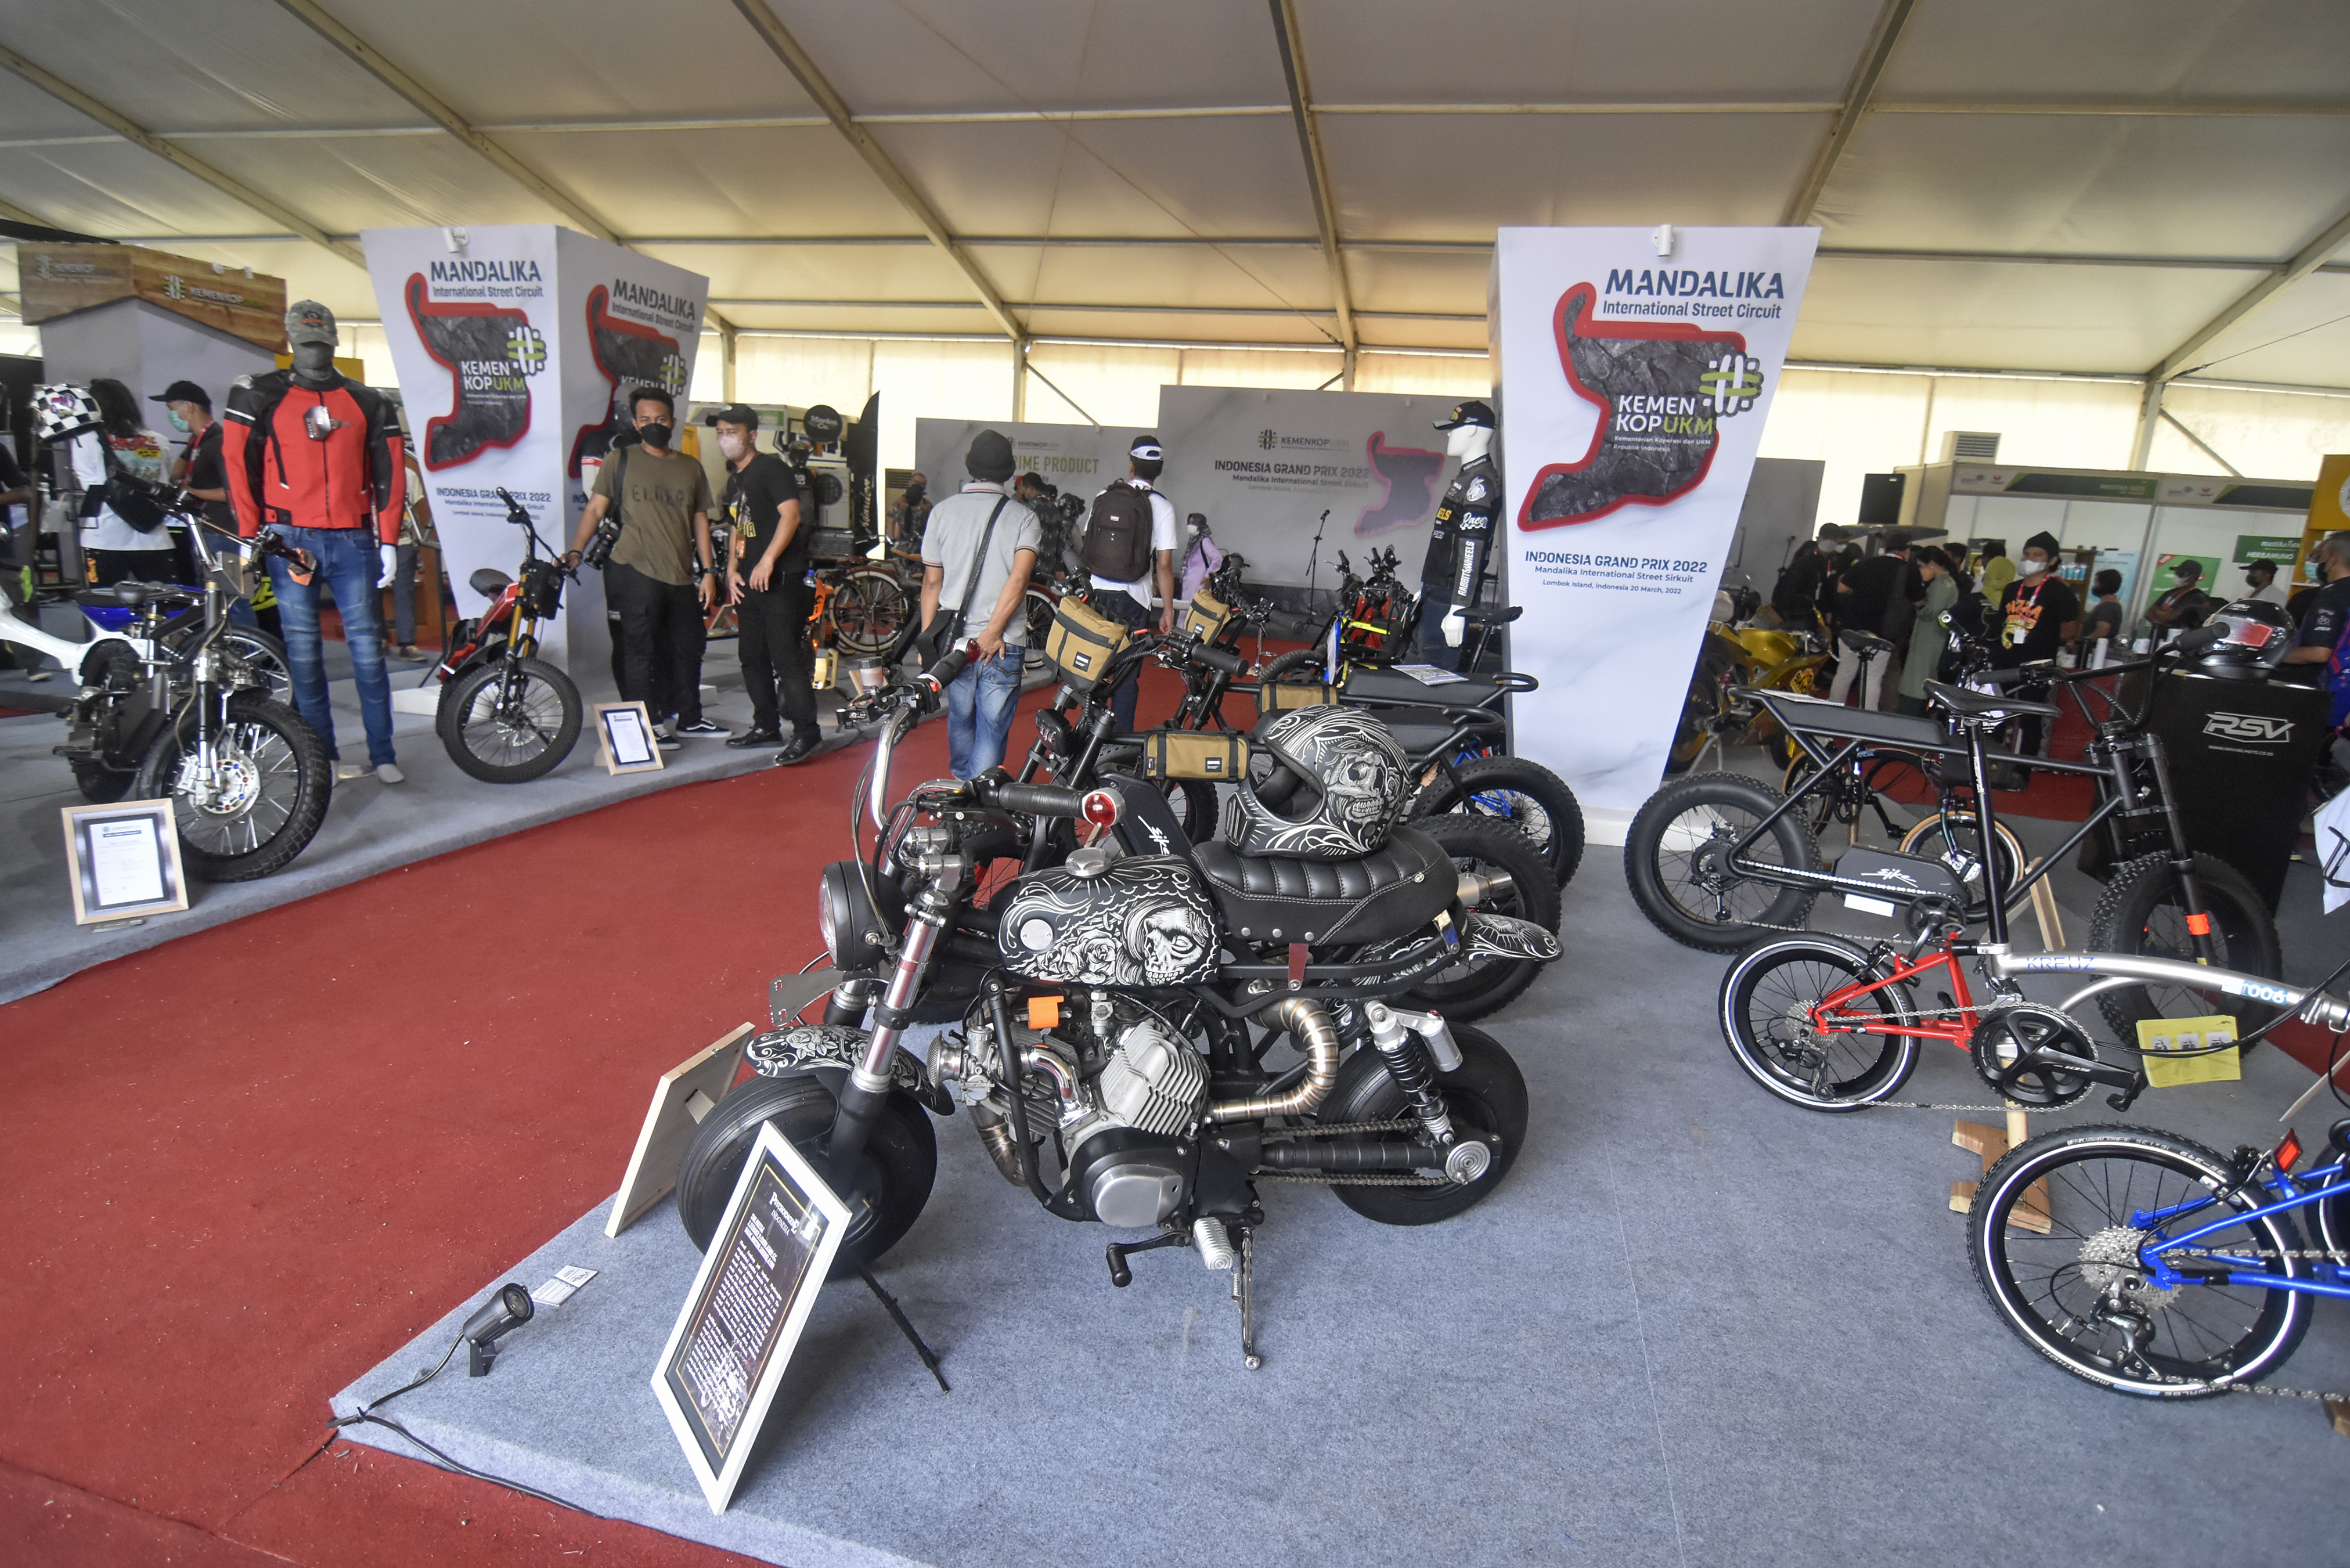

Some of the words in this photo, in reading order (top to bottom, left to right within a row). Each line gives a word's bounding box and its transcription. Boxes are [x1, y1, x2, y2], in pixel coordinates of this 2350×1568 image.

[431, 261, 542, 282] MANDALIKA
[433, 286, 486, 297] International
[488, 287, 514, 297] Street
[516, 286, 543, 297] Circuit
[1605, 269, 1784, 300] MANDALIKA
[613, 278, 695, 321] MANDALIKA
[612, 302, 655, 323] International
[655, 313, 674, 329] Street
[675, 320, 694, 334] Circuit
[1603, 300, 1688, 316] International
[1692, 302, 1733, 318] Street
[1736, 304, 1782, 319] Circuit
[461, 361, 510, 376] KEMEN
[1619, 395, 1695, 415] KEMEN
[1616, 414, 1713, 435] KOPUKM
[1044, 457, 1099, 474] PRODUCT
[1214, 460, 1271, 474] INDONESIA
[1274, 463, 1310, 475] GRAND
[1313, 466, 1338, 477] PRIX
[1340, 467, 1369, 478] 2022
[1232, 474, 1270, 483] Mandalika
[1271, 477, 1318, 486] International
[1320, 480, 1343, 488] Street
[1344, 480, 1369, 489] Sirkuit
[436, 487, 478, 499] INDONESIA
[529, 492, 552, 502] 2022
[1461, 511, 1488, 528] Racer
[1524, 550, 1591, 565] INDONESIA
[1594, 555, 1639, 569] GRAND
[1641, 558, 1670, 571] PRIX
[1673, 560, 1707, 573] 2022
[1534, 565, 1578, 575] Mandalika
[1580, 568, 1635, 579] International
[1637, 572, 1663, 581] Street
[1665, 573, 1693, 583] Sirkuit
[1572, 581, 1594, 590] Island,
[1595, 583, 1628, 591] Indonesia
[1641, 586, 1664, 594] March,
[2205, 713, 2296, 740] RSV
[2027, 957, 2096, 971] KREUZ
[2246, 984, 2286, 1004] 006
[771, 1209, 790, 1235] INDONESIA
[2041, 1348, 2111, 1386] MARATHON
[2164, 1386, 2220, 1397] CHWALBE
